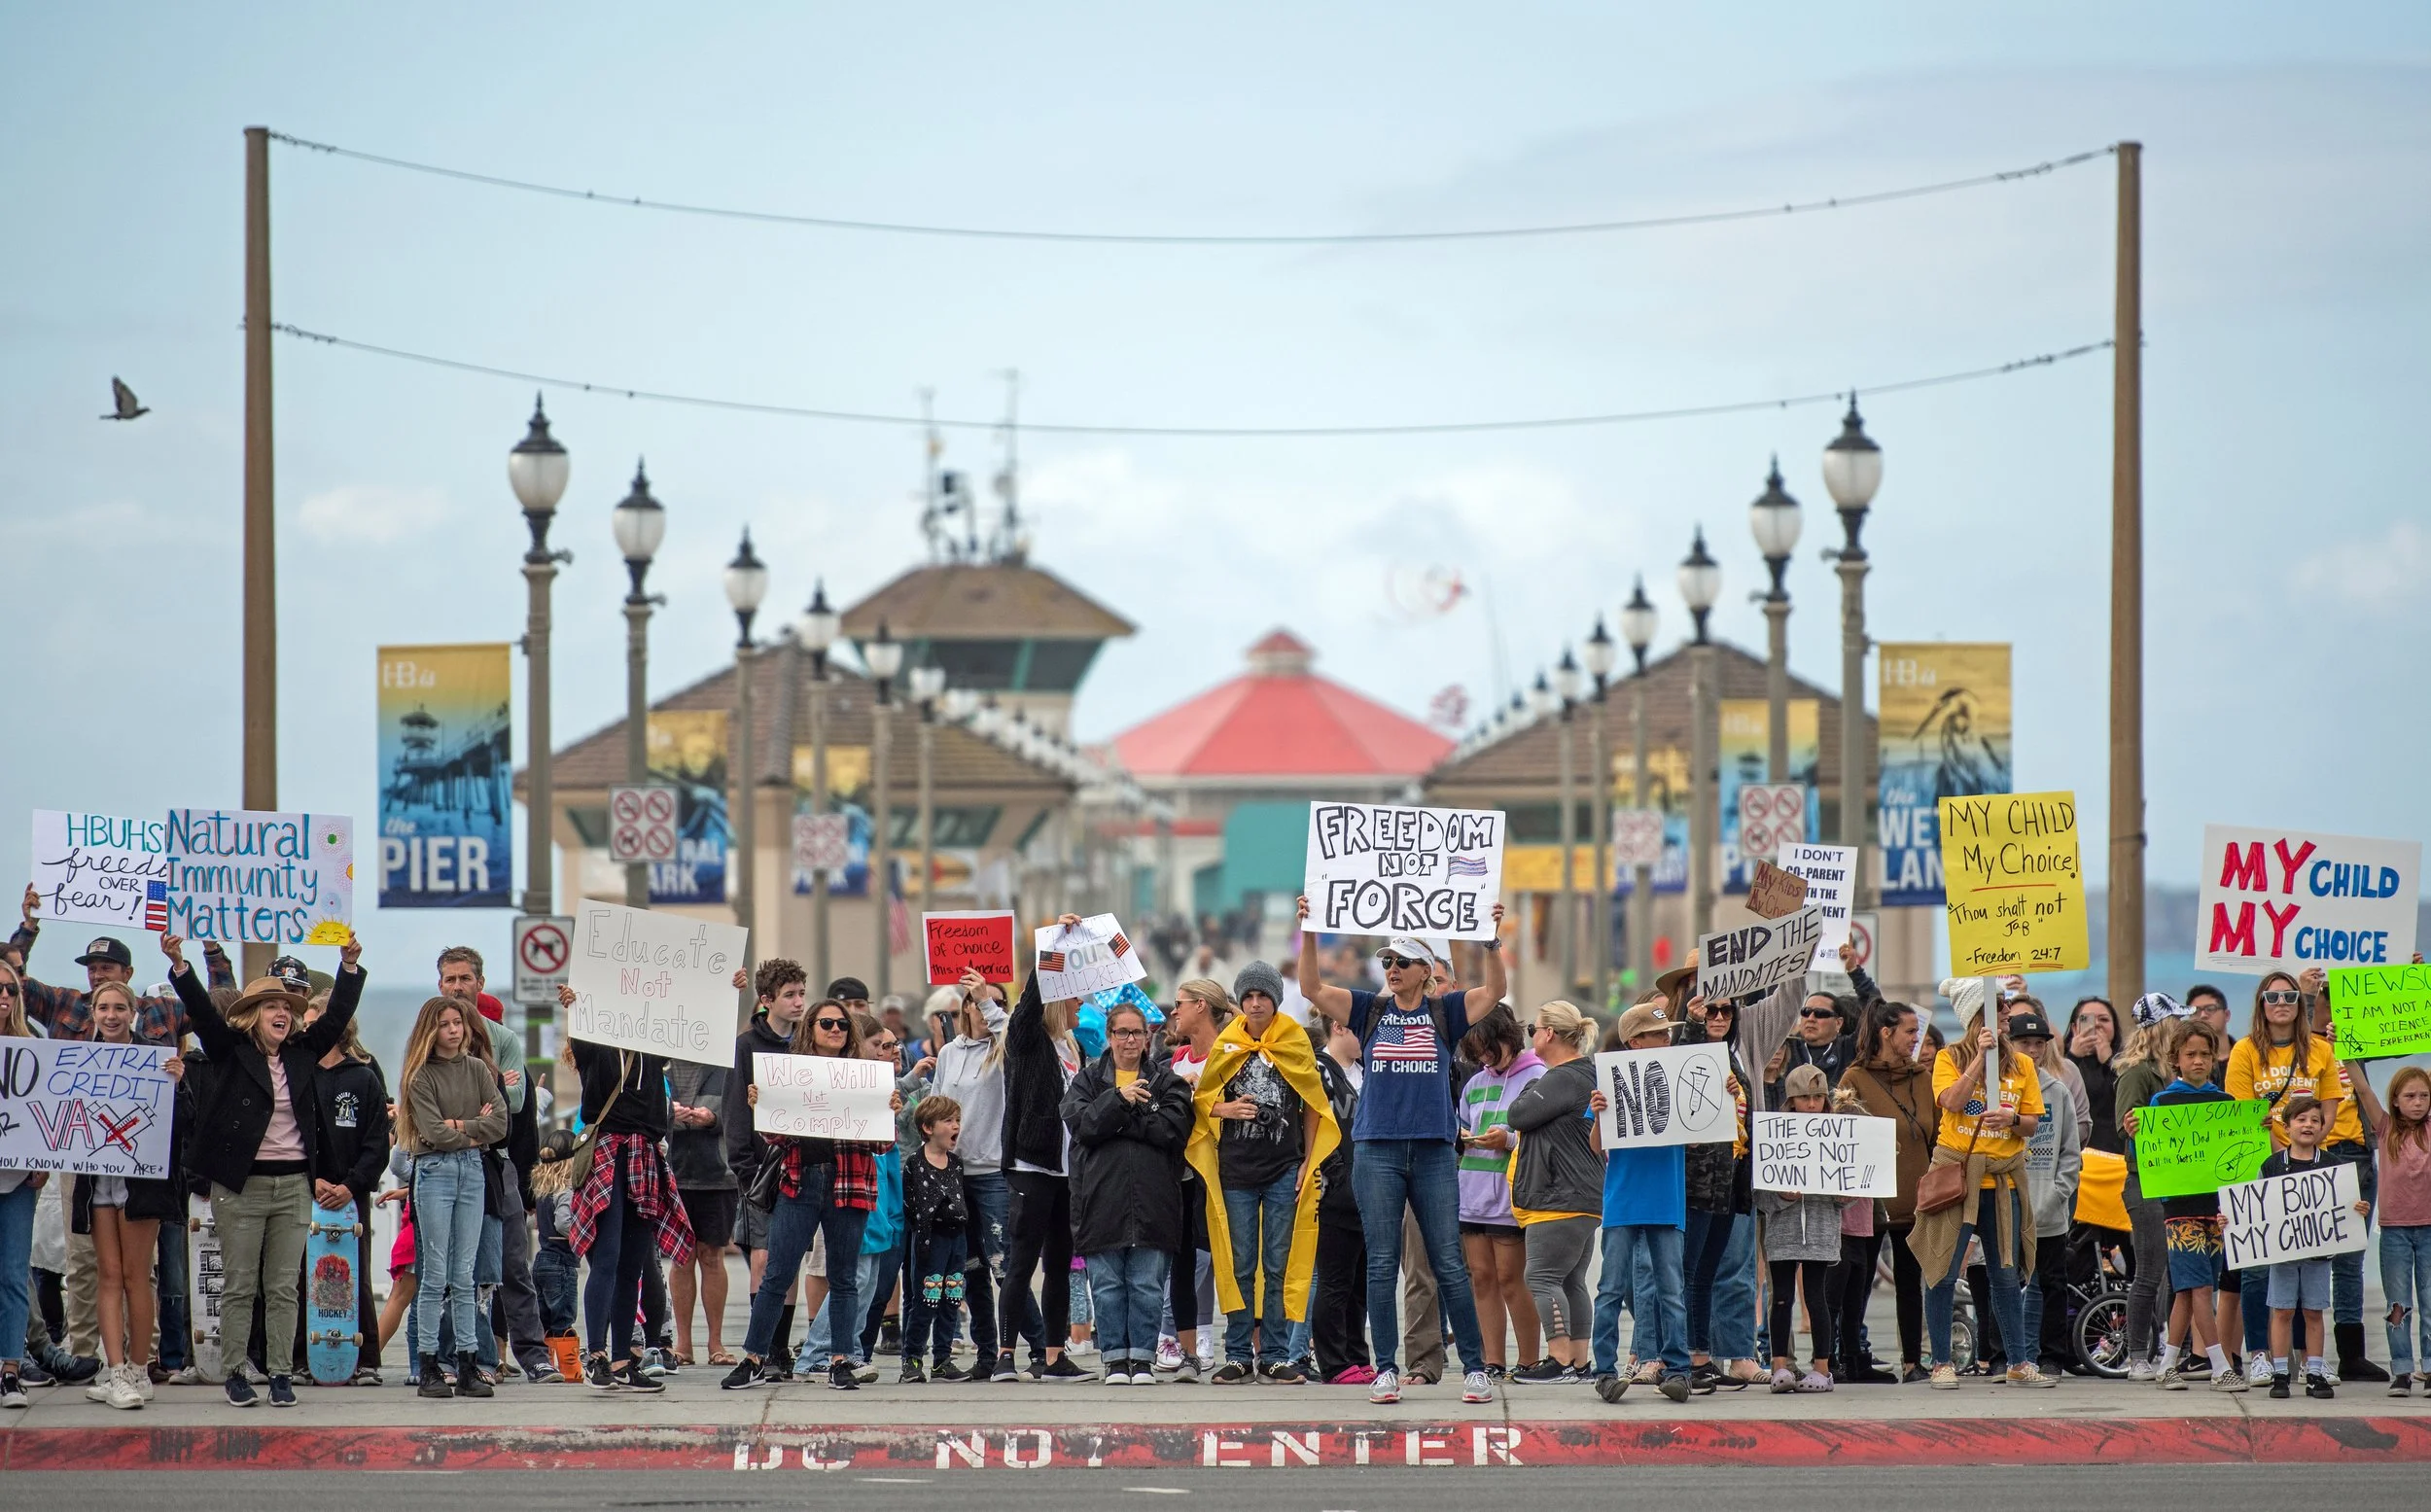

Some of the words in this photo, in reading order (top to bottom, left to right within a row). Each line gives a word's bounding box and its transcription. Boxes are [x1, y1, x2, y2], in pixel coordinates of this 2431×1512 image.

[67, 813, 167, 853] HBUHS
[1317, 806, 1494, 860] FREEDOM
[1879, 806, 1940, 847] WE
[1950, 801, 1991, 836] MY
[2008, 800, 2074, 836] CHILD
[167, 809, 310, 860] Natural
[378, 836, 489, 892] PIER
[1378, 853, 1439, 877] NOT
[1794, 848, 1798, 859] I
[1803, 849, 1844, 862] DON'T
[1964, 844, 1994, 884] My
[2000, 842, 2078, 879] Choice!
[2220, 838, 2317, 895] MY
[2309, 860, 2400, 898] CHILD
[99, 877, 142, 893] OVER
[166, 858, 318, 906] Immunity
[1756, 863, 1777, 896] My
[1806, 867, 1846, 881] PARENT
[1819, 889, 1838, 900] THE
[1995, 894, 2027, 917] shalt
[2035, 892, 2067, 915] not
[167, 896, 308, 944] Matters
[929, 921, 989, 939] Freedom
[2209, 899, 2302, 958] MY
[2295, 927, 2389, 963] CHOICE
[587, 910, 727, 974] Educate
[934, 943, 947, 958] of
[1708, 926, 1772, 967] END
[1775, 908, 1819, 950] THE
[1069, 942, 1110, 969] OUR
[2030, 947, 2061, 961] 24:7
[621, 967, 671, 999] Not
[931, 963, 953, 980] this
[1040, 959, 1133, 999] CHILDREN
[1703, 942, 1817, 1002] MANDATES!
[574, 991, 710, 1051] Mandate
[2362, 1005, 2385, 1019] AM
[2392, 1001, 2416, 1015] NOT
[2379, 1016, 2430, 1035] SCIENCE
[55, 1046, 159, 1071] EXTRA
[763, 1056, 814, 1087] We
[827, 1061, 877, 1089] Will
[1371, 1060, 1388, 1073] OF
[1391, 1060, 1439, 1073] CHOICE
[48, 1071, 168, 1108] CREDIT
[803, 1089, 828, 1104] Not
[1611, 1060, 1670, 1139] NO
[770, 1107, 868, 1139] Comply
[2253, 1104, 2262, 1113] is
[1758, 1116, 1798, 1139] THE
[1806, 1117, 1857, 1140] GOV'T
[2193, 1131, 2210, 1146] Dad
[25, 1157, 65, 1170] KNOW
[73, 1161, 99, 1173] WHO
[102, 1163, 125, 1175] YOU
[1759, 1142, 1812, 1162] DOES
[1819, 1143, 1859, 1164] NOT
[1762, 1164, 1808, 1188] OWN
[2229, 1180, 2269, 1225] MY
[2281, 1168, 2339, 1215] BODY
[2230, 1223, 2270, 1263] MY
[2279, 1206, 2347, 1250] CHOICE
[318, 1308, 348, 1319] HOCKEY
[1203, 1425, 1524, 1467] ENTER
